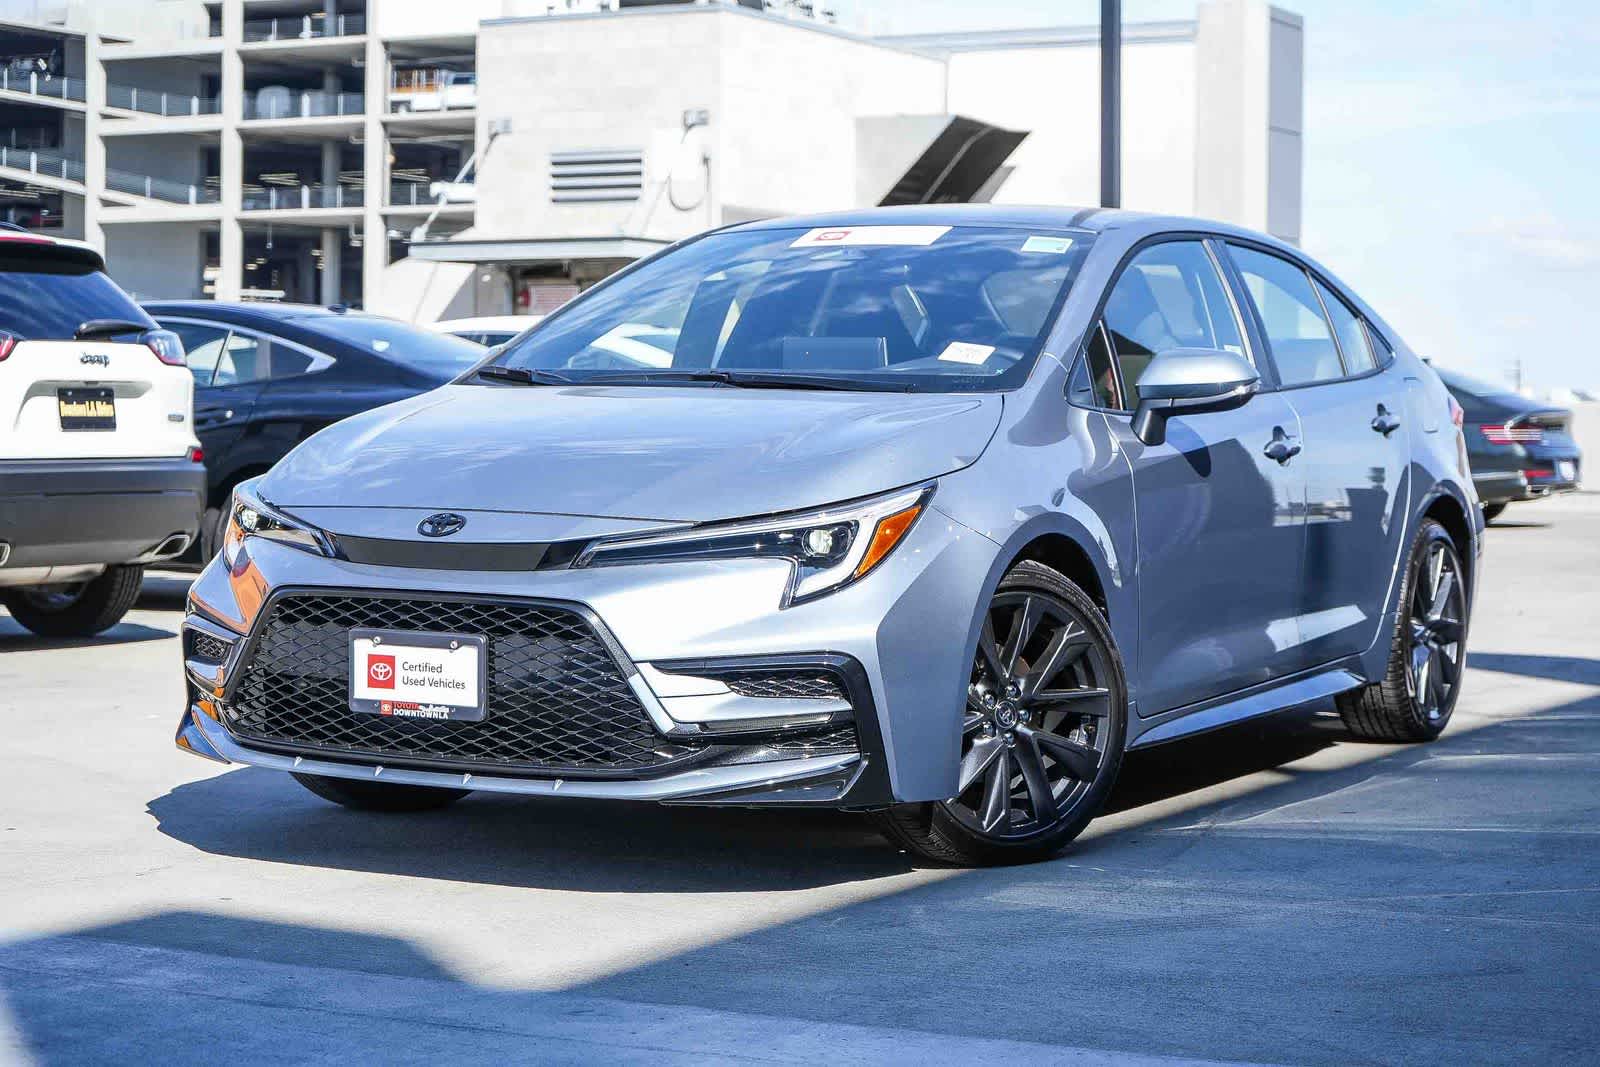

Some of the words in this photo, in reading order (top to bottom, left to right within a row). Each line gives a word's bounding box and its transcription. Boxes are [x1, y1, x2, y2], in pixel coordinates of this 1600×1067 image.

[402, 661, 443, 673] Certified
[402, 676, 426, 687] Used
[427, 678, 466, 689] Vehicles
